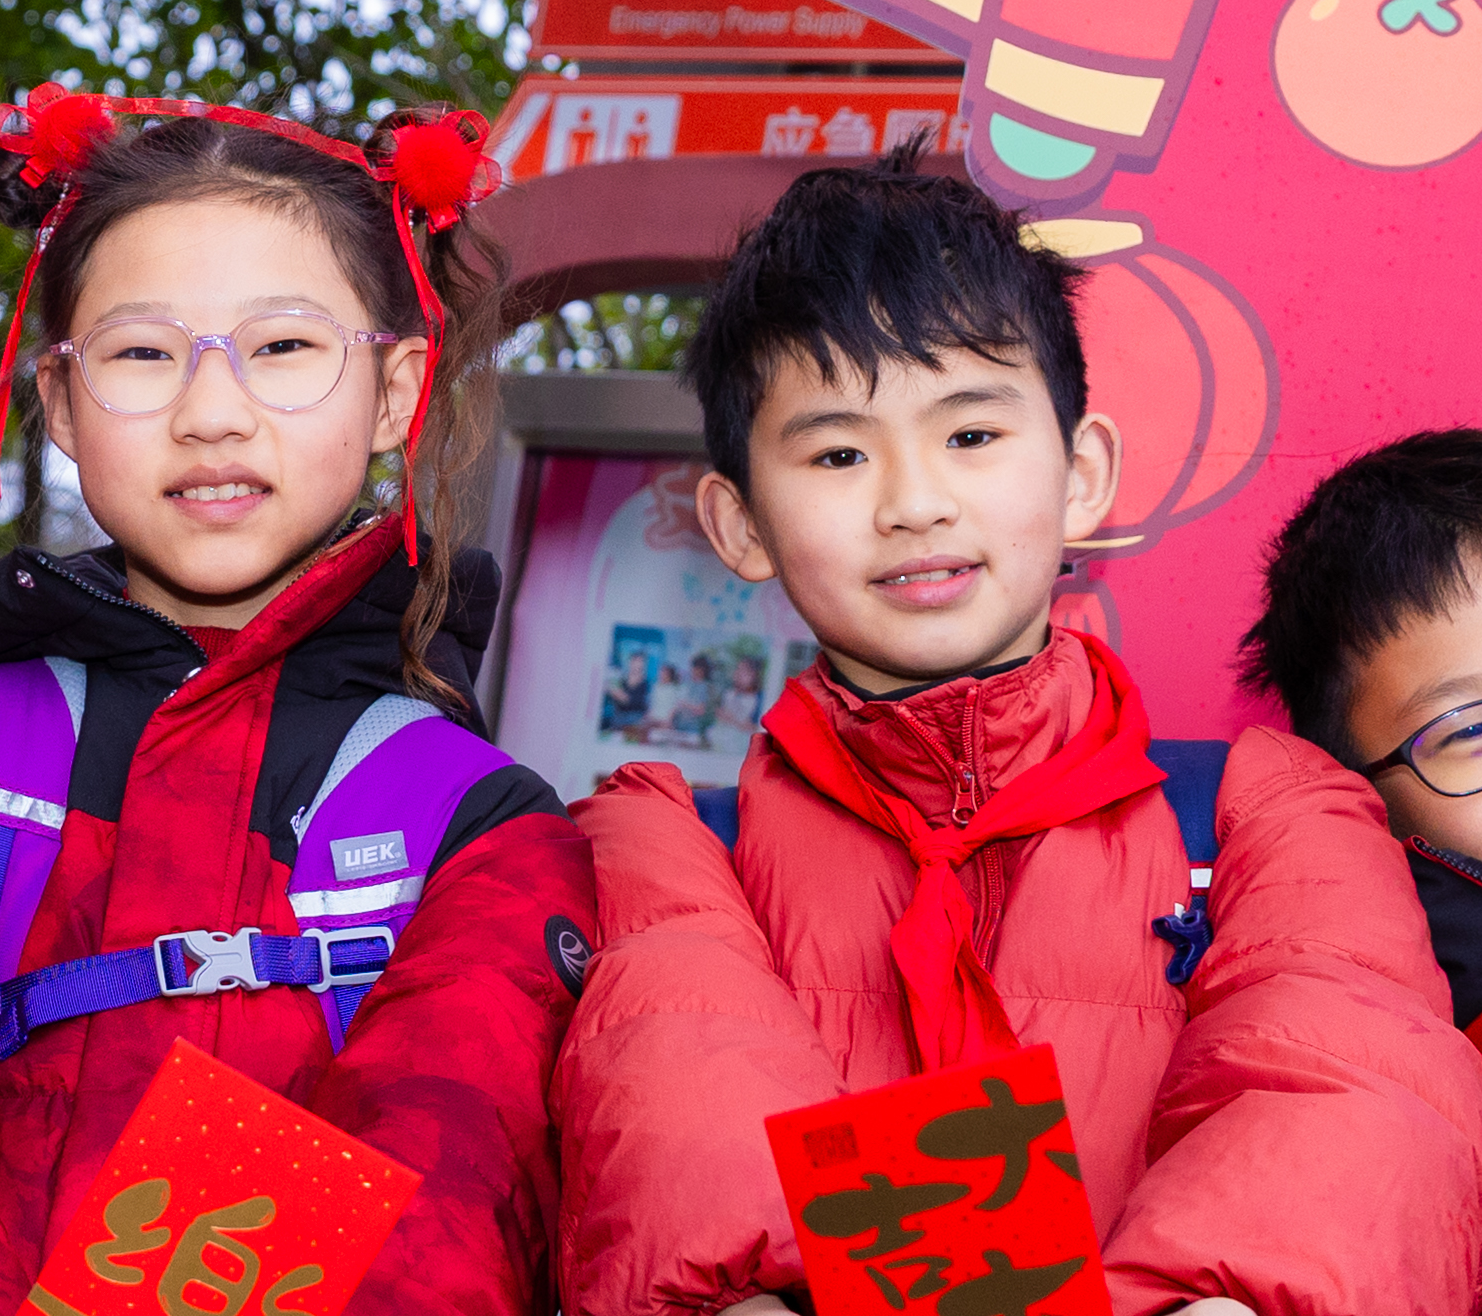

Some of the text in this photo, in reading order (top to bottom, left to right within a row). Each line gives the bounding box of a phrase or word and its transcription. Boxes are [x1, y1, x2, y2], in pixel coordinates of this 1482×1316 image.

[609, 5, 720, 39] Emergency
[725, 5, 788, 35] Power
[344, 841, 396, 867] UEK
